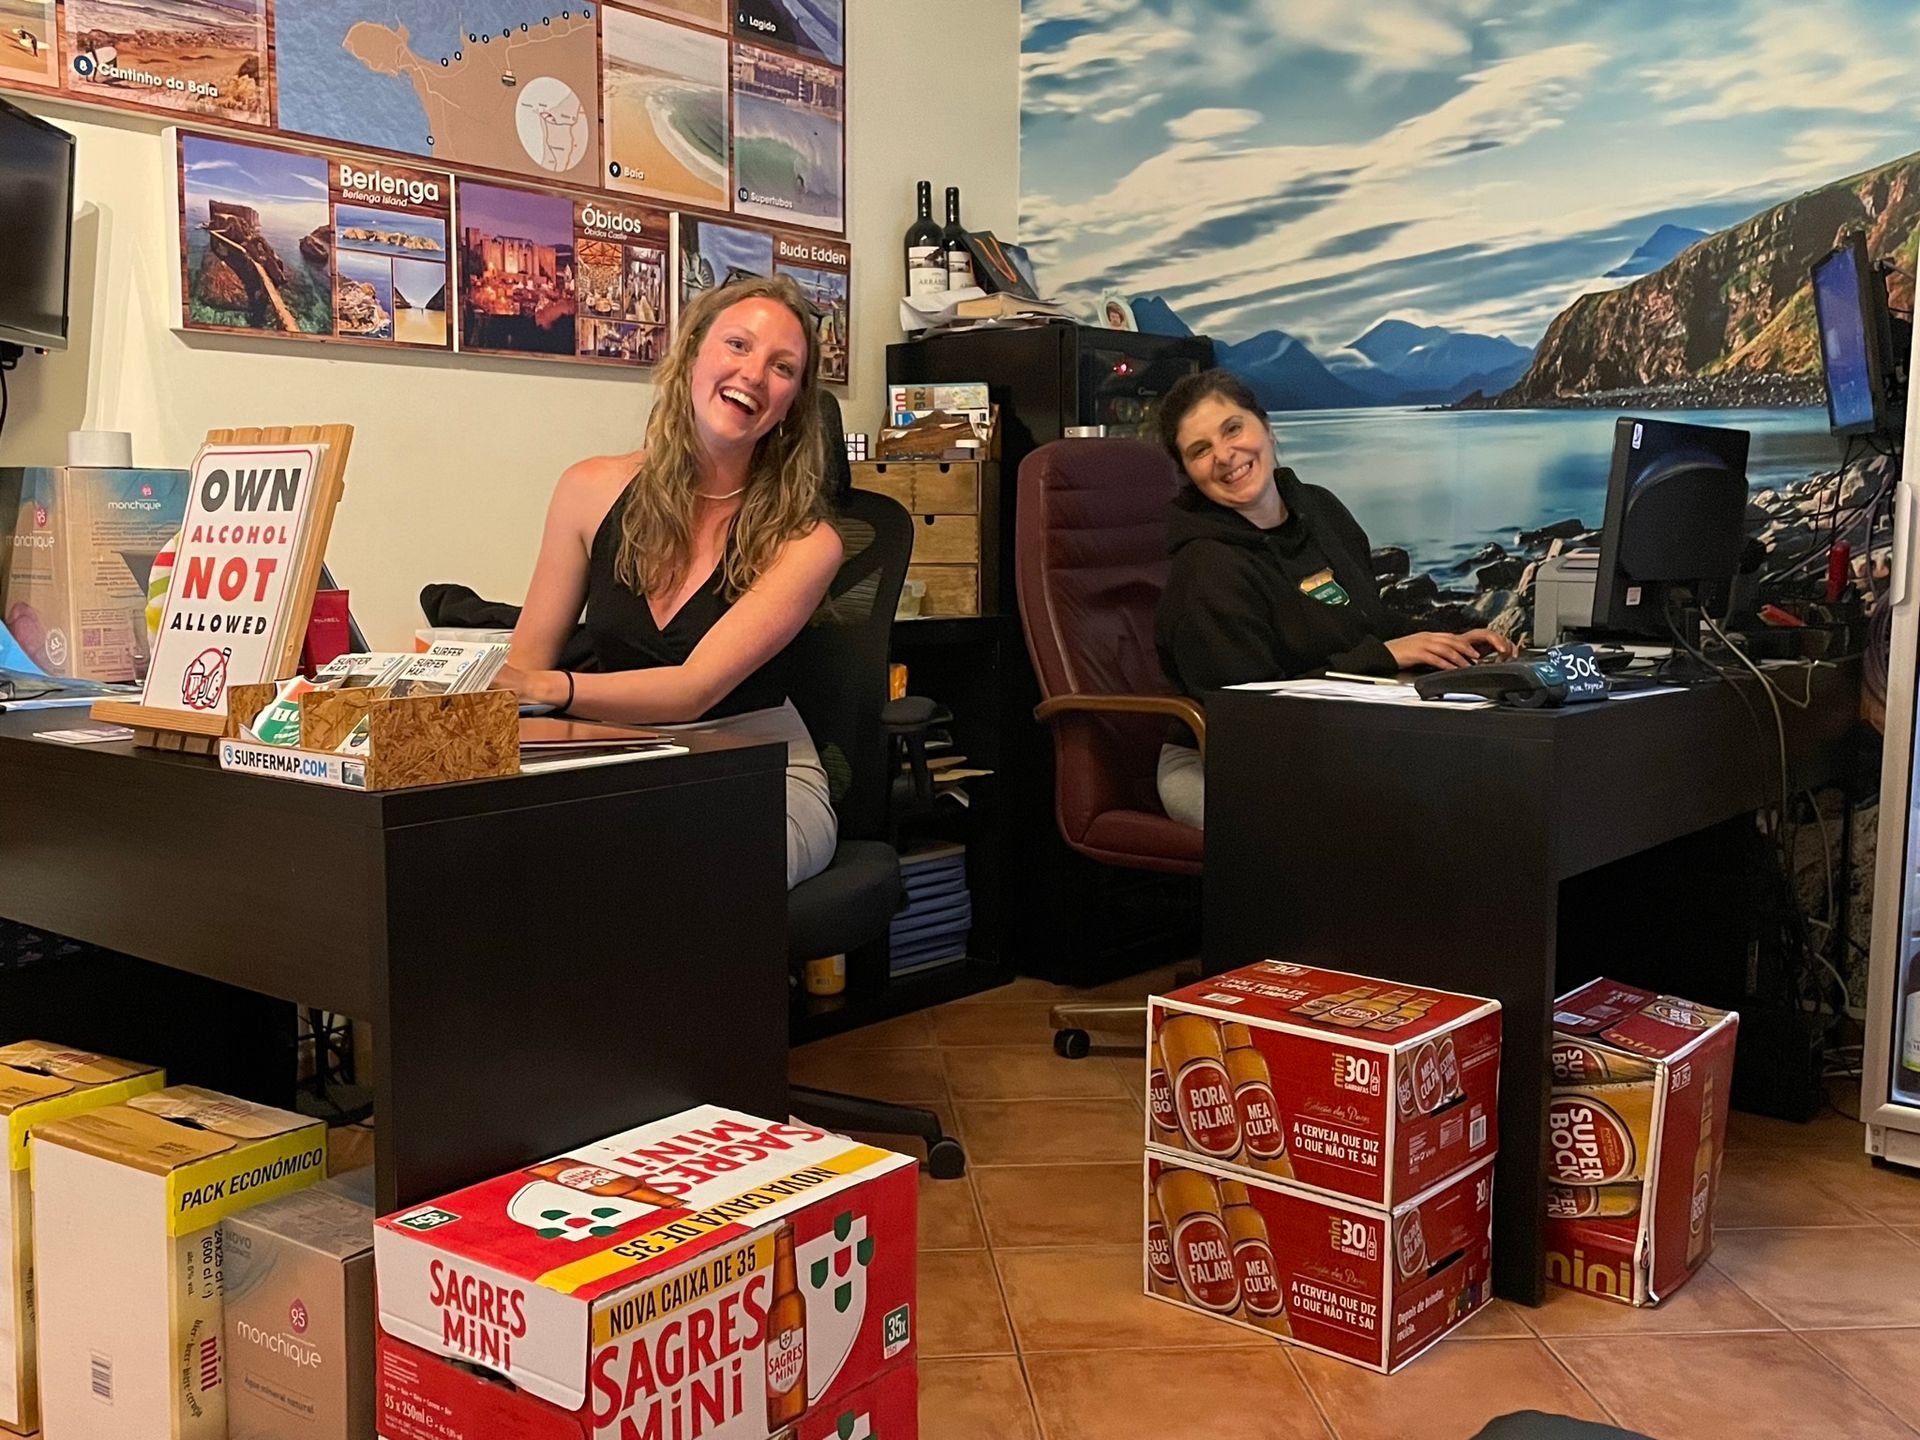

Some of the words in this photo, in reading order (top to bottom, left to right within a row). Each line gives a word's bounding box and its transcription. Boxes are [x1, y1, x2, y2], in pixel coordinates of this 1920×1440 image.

[750, 16, 776, 32] Lagido
[79, 60, 88, 71] 8
[98, 63, 162, 86] Cantinho
[166, 77, 184, 90] da
[188, 80, 218, 97] Baía
[340, 164, 439, 204] Berlenga
[342, 189, 380, 204] Berlenga
[382, 195, 408, 207] Island
[740, 190, 748, 200] 10
[750, 192, 793, 208] Supertubos
[582, 203, 642, 234] Óbidos
[780, 242, 809, 259] Buda
[811, 246, 846, 266] Edden
[201, 468, 302, 512] OWN
[108, 500, 162, 512] monchique
[191, 525, 288, 544] ALCOHOL
[182, 556, 278, 602] NOT
[170, 612, 267, 635] ALLOWED
[414, 658, 448, 669] SURFER
[430, 646, 464, 656] SURFER
[234, 749, 328, 778] SURFERMAP.COM
[1332, 1052, 1345, 1088] mini
[1344, 1056, 1370, 1086] 30
[1420, 1058, 1435, 1081] MEA
[1420, 1069, 1440, 1100] CULPA
[1190, 1084, 1228, 1108] BORA
[1247, 1102, 1271, 1120] MEA
[1190, 1104, 1236, 1130] FALAR?
[1246, 1118, 1280, 1136] CULPA
[1293, 1122, 1300, 1134] A
[1302, 1124, 1339, 1144] CERVEJA
[1342, 1134, 1361, 1148] QUE
[1363, 1139, 1379, 1153] DIZ
[1295, 1136, 1302, 1148] O
[1304, 1138, 1324, 1154] QUE
[1326, 1144, 1345, 1158] NÃO
[1347, 1150, 1359, 1162] TE
[1361, 1153, 1376, 1166] SAI
[1550, 1112, 1581, 1178] BOCK
[1570, 1108, 1604, 1180] SUPER
[639, 1123, 824, 1196] SAGRES
[180, 1180, 226, 1212] PACK
[229, 1148, 323, 1196] ECONÓMICO
[768, 1166, 841, 1196] NOVA
[695, 1190, 776, 1228] CAIXA
[650, 1222, 696, 1245] DE
[1341, 1219, 1366, 1250] 30
[201, 1236, 213, 1264] (600
[612, 1240, 655, 1261] 35
[1188, 1240, 1226, 1262] BORA
[203, 1267, 214, 1280] cl
[1246, 1260, 1270, 1276] MEA
[430, 1260, 526, 1339] SAGRES
[610, 1291, 656, 1337] NOVA
[661, 1266, 709, 1312] CAIXA
[713, 1254, 732, 1289] DE
[736, 1244, 756, 1277] 35
[1244, 1276, 1278, 1293] CULPA
[1292, 1280, 1298, 1292] A
[1300, 1284, 1338, 1305] CERVEJA
[1340, 1296, 1358, 1312] QUE
[1360, 1301, 1376, 1317] DIZ
[888, 1313, 907, 1342] 35x
[1294, 1296, 1300, 1306] O
[1302, 1298, 1322, 1314] QUE
[1324, 1304, 1343, 1320] NÃO
[1345, 1311, 1356, 1324] TE
[1358, 1316, 1374, 1330] SAI
[238, 1320, 322, 1368] monchique
[592, 1274, 768, 1429] SAGRES
[200, 1336, 222, 1392] mini
[768, 1343, 803, 1376] SAGRES
[775, 1362, 797, 1384] MINI
[384, 1392, 394, 1410] 35
[396, 1402, 401, 1412] x
[402, 1400, 425, 1424] 250ml
